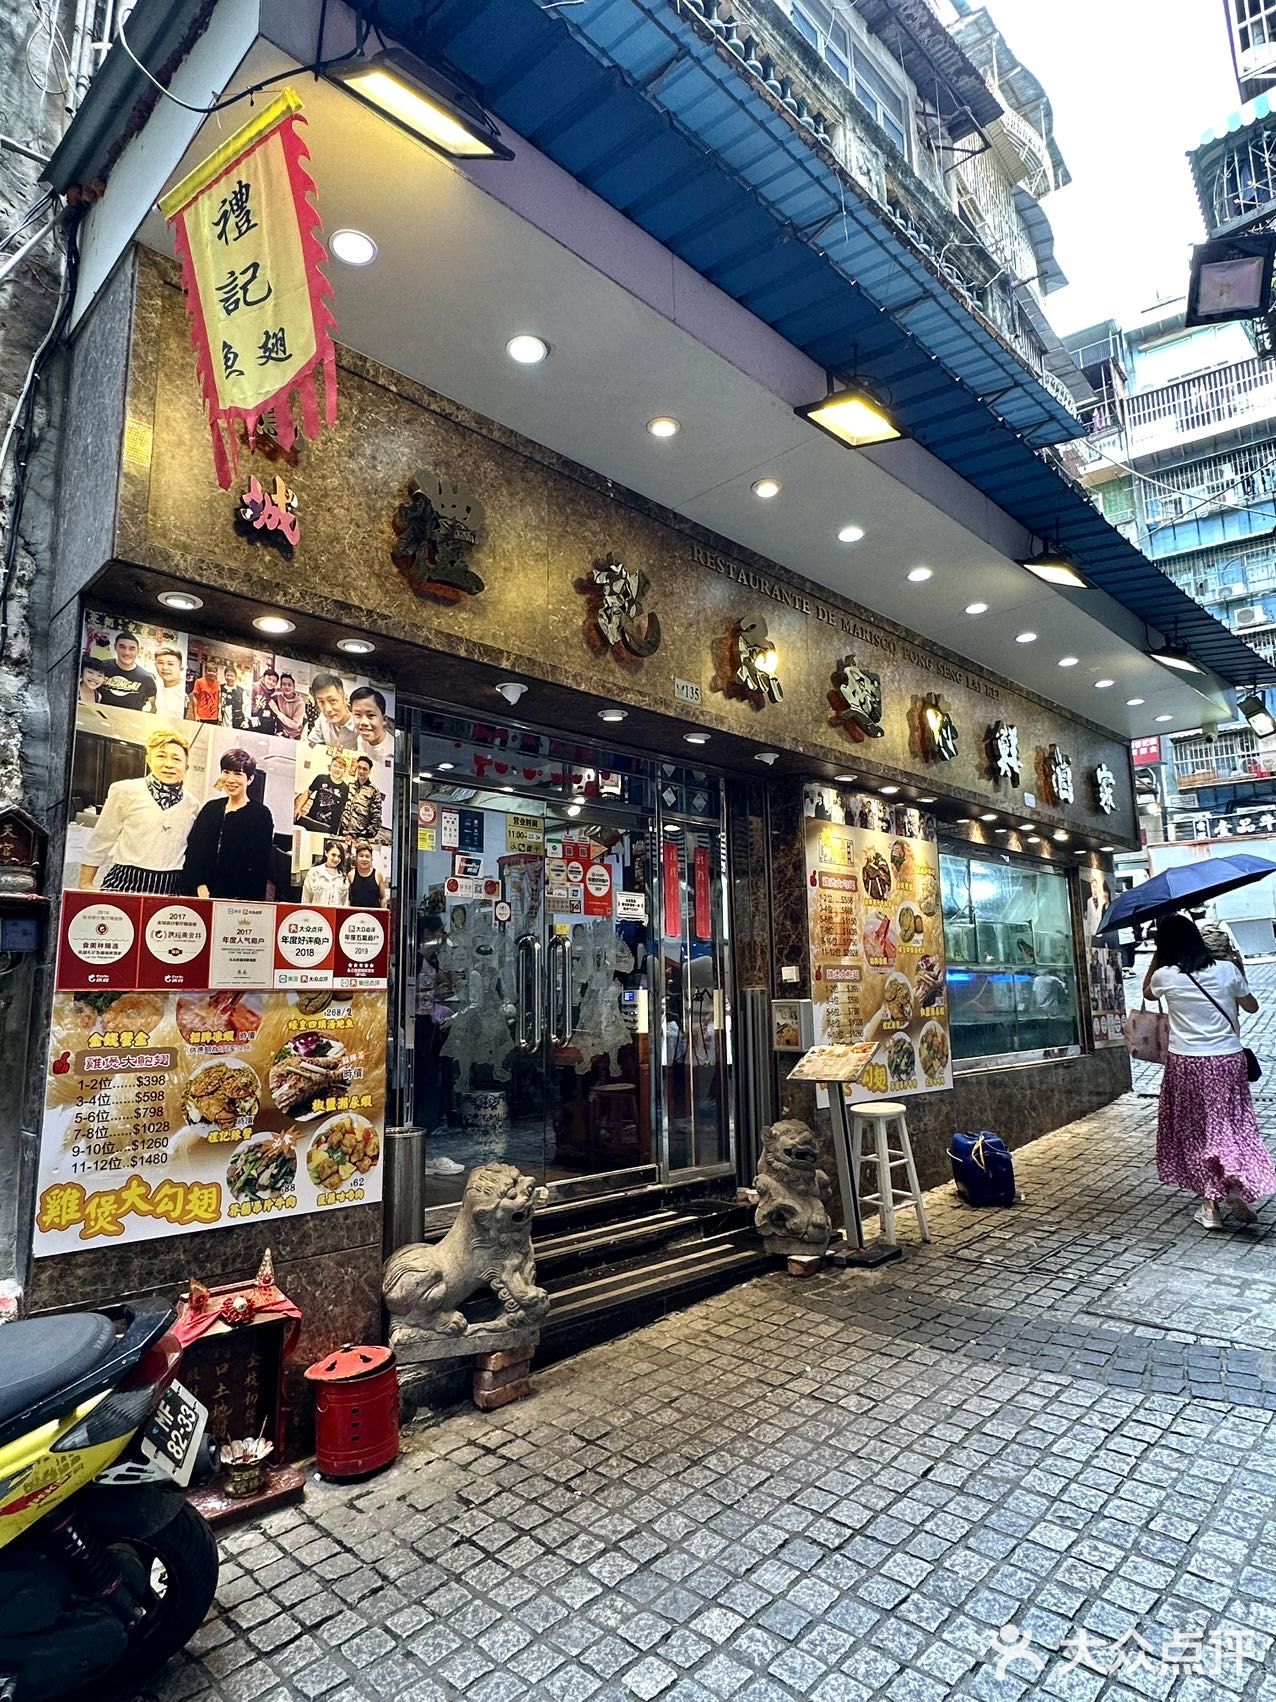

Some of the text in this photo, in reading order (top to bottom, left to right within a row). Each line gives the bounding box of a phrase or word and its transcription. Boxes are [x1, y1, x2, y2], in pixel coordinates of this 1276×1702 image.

[691, 544, 811, 615] RESTAURANTE
[816, 605, 837, 627] DE
[841, 617, 897, 656] MARISCO
[169, 912, 187, 920] 2017
[236, 928, 253, 936] 2017
[299, 925, 323, 933] 大众点评
[281, 936, 330, 946] 年度好评商户
[295, 948, 315, 957] 2018
[354, 947, 369, 955] 2019
[154, 1400, 174, 1433] MF
[166, 1404, 196, 1460] 82-33
